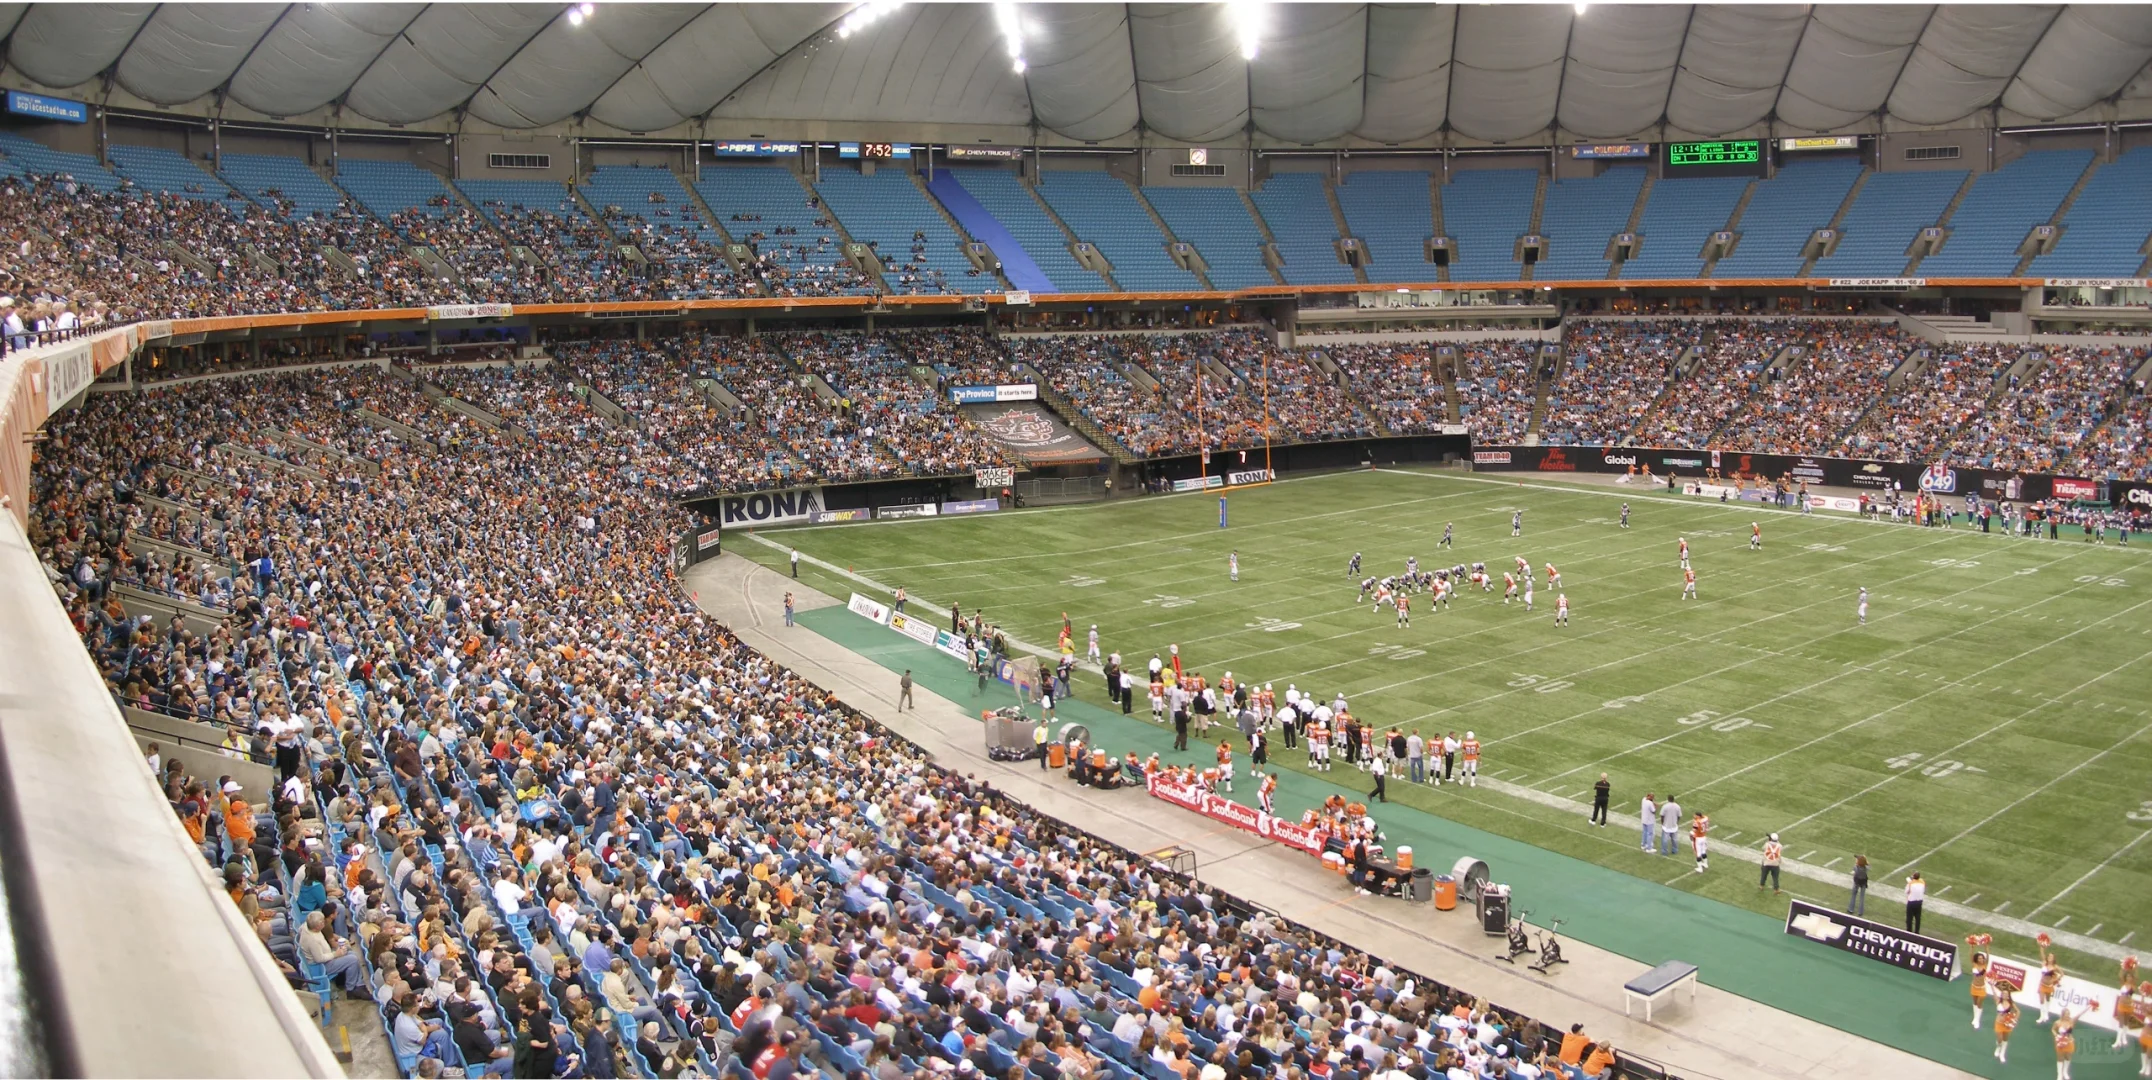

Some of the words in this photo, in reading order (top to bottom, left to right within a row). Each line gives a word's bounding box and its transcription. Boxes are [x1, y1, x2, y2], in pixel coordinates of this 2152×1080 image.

[729, 144, 756, 152] PEPSI
[771, 144, 798, 152] PEPSI
[865, 144, 891, 157] 7:52
[1674, 145, 1699, 153] 12:14
[964, 389, 995, 399] Province
[1021, 388, 1034, 396] here.
[1475, 452, 1493, 460] TEAM
[1493, 452, 1510, 460] 1040
[1547, 448, 1566, 460] Tim
[1605, 455, 1636, 465] Global
[1539, 457, 1576, 470] Hortons
[983, 468, 1009, 479] MAKE
[723, 490, 821, 523] RONA
[818, 511, 855, 523] SUBWAY
[892, 613, 906, 630] OK
[1506, 672, 1575, 693] 50
[1676, 709, 1754, 732] 50
[1884, 752, 1964, 777] 40
[1210, 802, 1257, 830] Scotiabank
[1849, 924, 1901, 949] CHEVY
[1899, 939, 1953, 965] TRUCK
[1846, 938, 1901, 962] DEALERS
[1909, 959, 1925, 969] OF
[1933, 965, 1950, 977] BC
[1992, 964, 2024, 978] WESTERN
[1996, 971, 2019, 983] FAMILY
